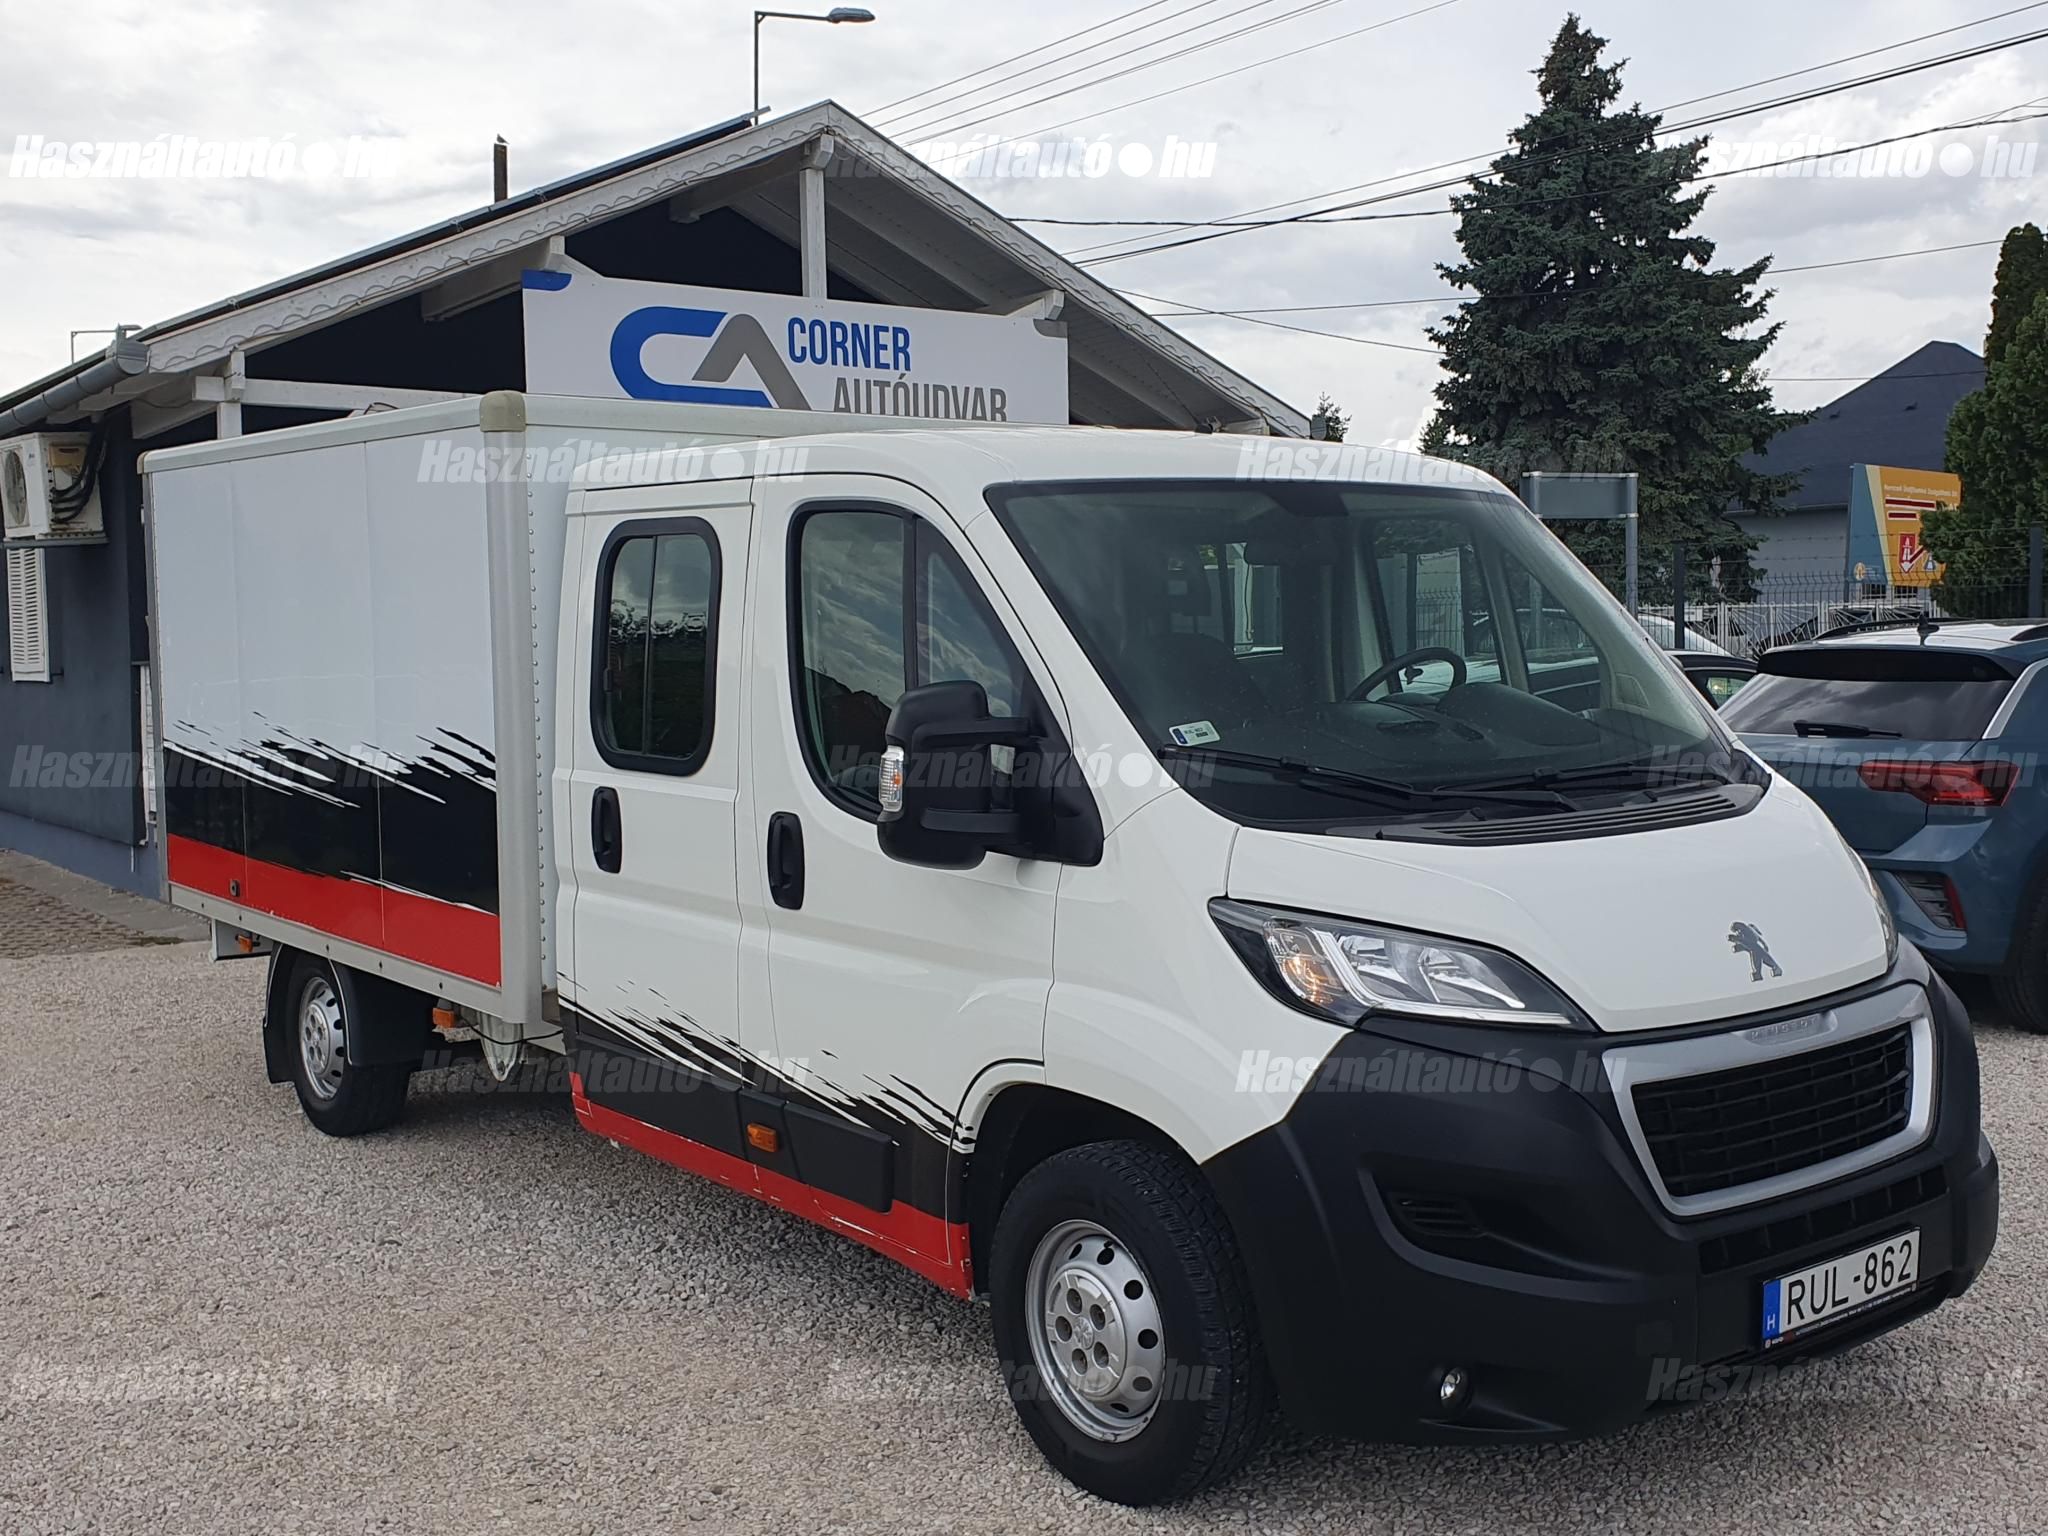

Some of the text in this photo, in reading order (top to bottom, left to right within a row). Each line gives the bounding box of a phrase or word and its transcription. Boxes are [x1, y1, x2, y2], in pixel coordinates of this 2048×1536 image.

[788, 317, 911, 371] CORNER
[833, 373, 1007, 422] AUTÓUDVAR
[1787, 1239, 1912, 1325] RUL-862
[1766, 1312, 1776, 1331] H
